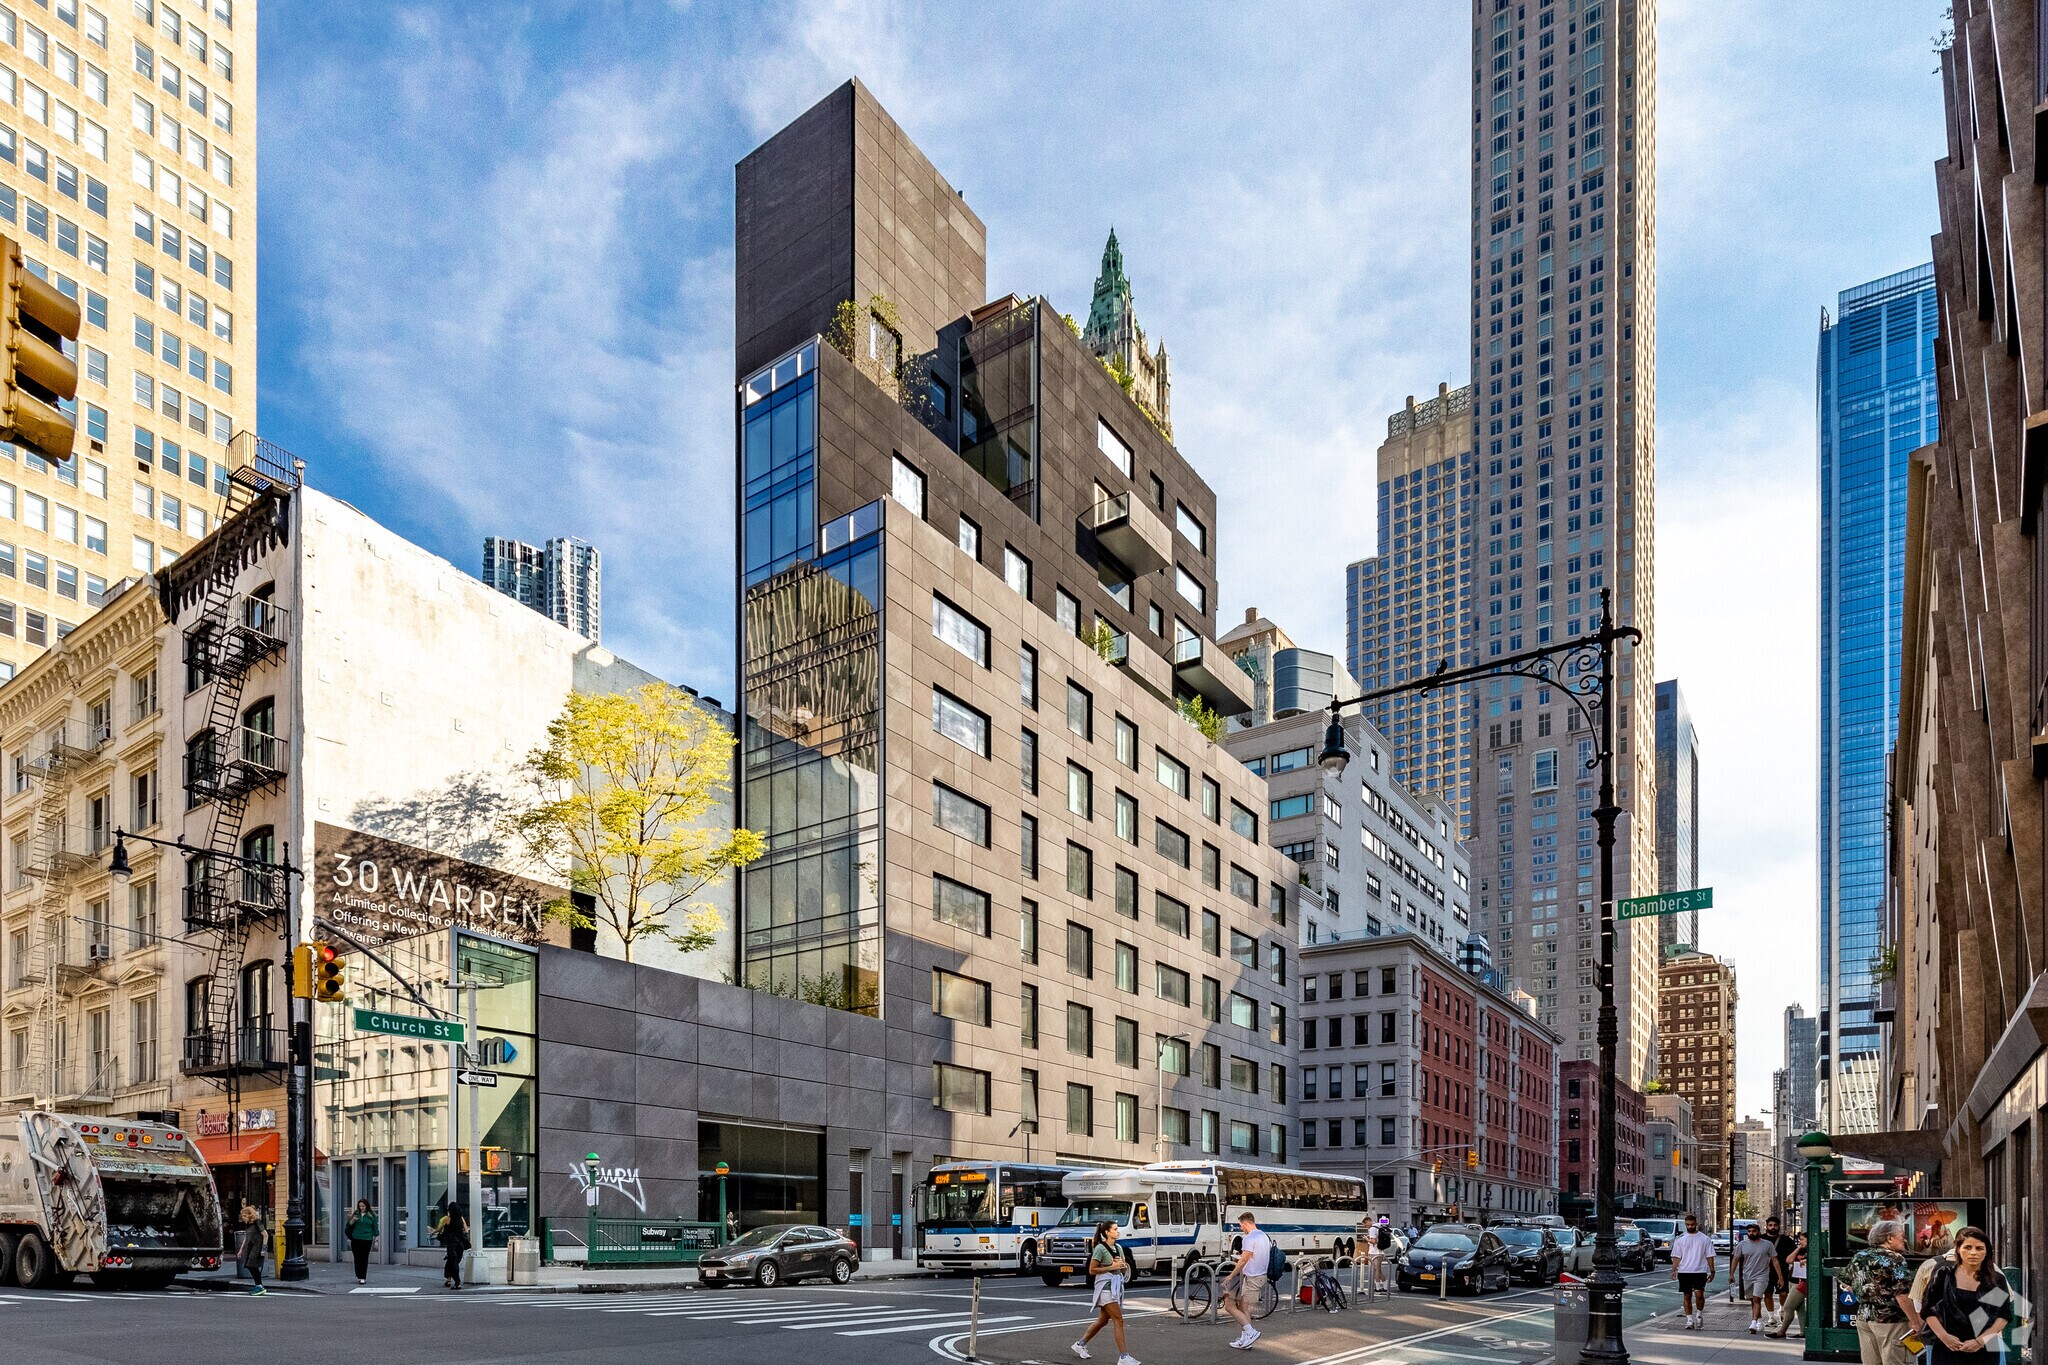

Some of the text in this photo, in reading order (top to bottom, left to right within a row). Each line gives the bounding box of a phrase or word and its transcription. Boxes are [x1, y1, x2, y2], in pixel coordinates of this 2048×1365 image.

[332, 853, 543, 931] 30 WARREN
[1622, 892, 1706, 917] Chambers St
[333, 892, 342, 903] A
[346, 894, 386, 913] Limited
[389, 904, 442, 925] Collection
[444, 918, 455, 927] of
[470, 922, 524, 944] Residences
[333, 909, 380, 931] Offering
[383, 922, 390, 931] a
[392, 921, 418, 936] New
[371, 1016, 450, 1037] Church St
[468, 1074, 493, 1084] ONE WAY
[204, 1122, 228, 1134] DONUTS
[642, 1228, 667, 1238] Subway
